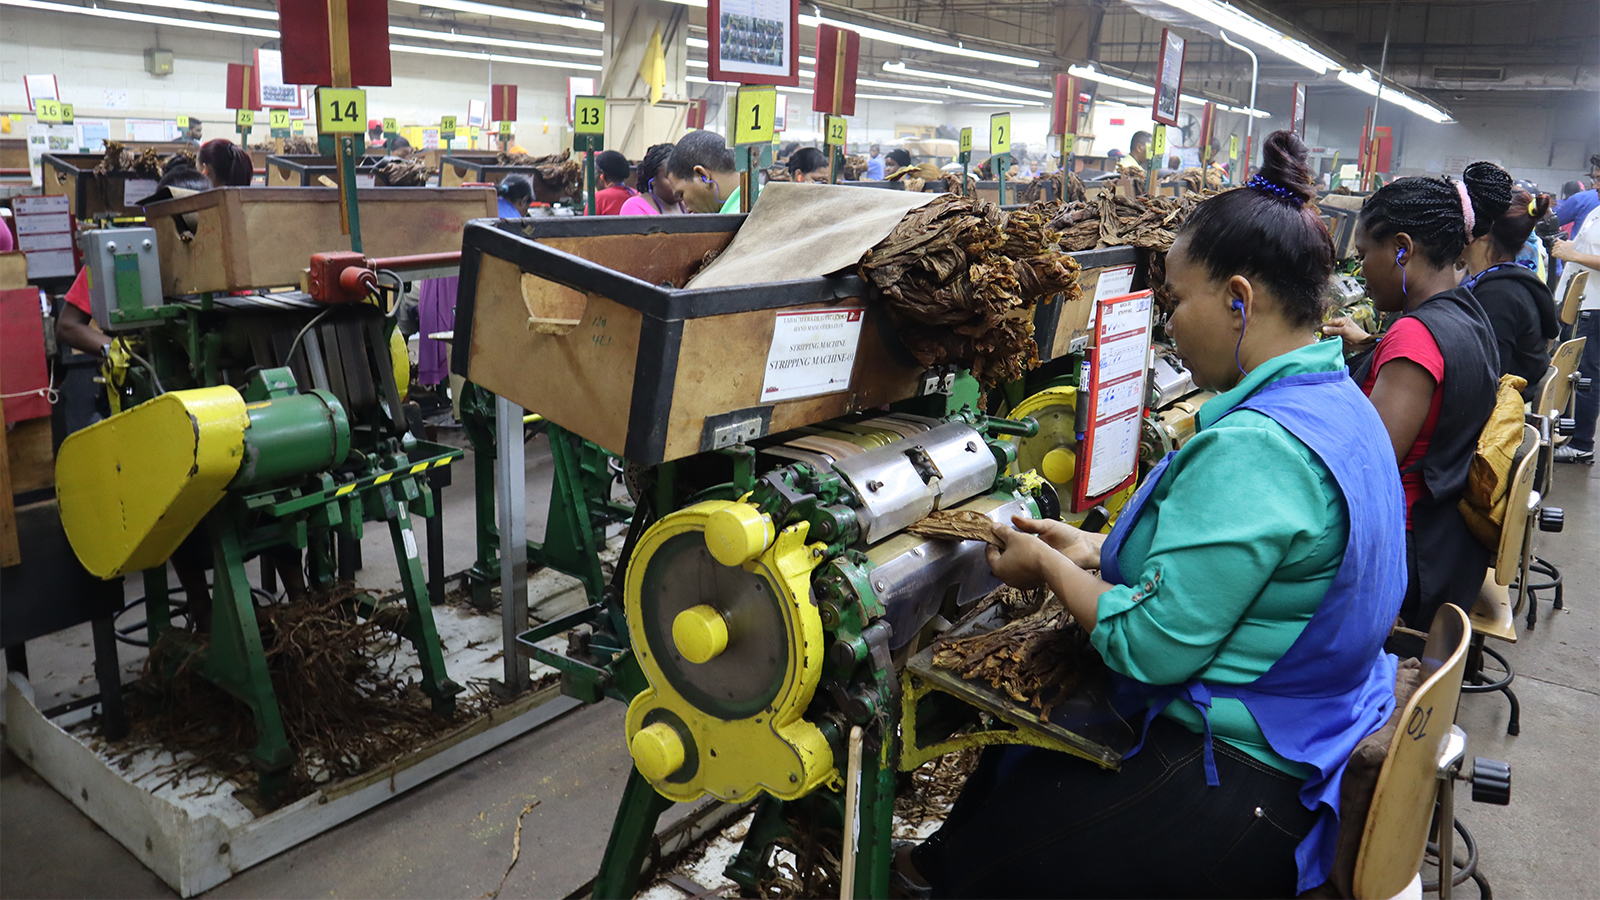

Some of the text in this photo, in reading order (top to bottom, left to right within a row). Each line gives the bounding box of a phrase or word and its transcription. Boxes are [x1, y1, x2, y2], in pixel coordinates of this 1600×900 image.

[42, 105, 57, 117] 16
[241, 113, 251, 123] 25
[331, 101, 359, 122] 14
[581, 108, 600, 125] 13
[751, 104, 761, 130] 1
[274, 115, 285, 123] 17
[385, 121, 394, 129] 24
[444, 120, 453, 129] 18
[831, 124, 843, 139] 12
[997, 126, 1004, 145] 2
[962, 135, 970, 147] 11
[1158, 133, 1163, 148] 3
[789, 340, 846, 351] STRIPPING MACHINE
[769, 353, 854, 369] STRIPPING MACHINE-01
[1407, 703, 1434, 741] 01
